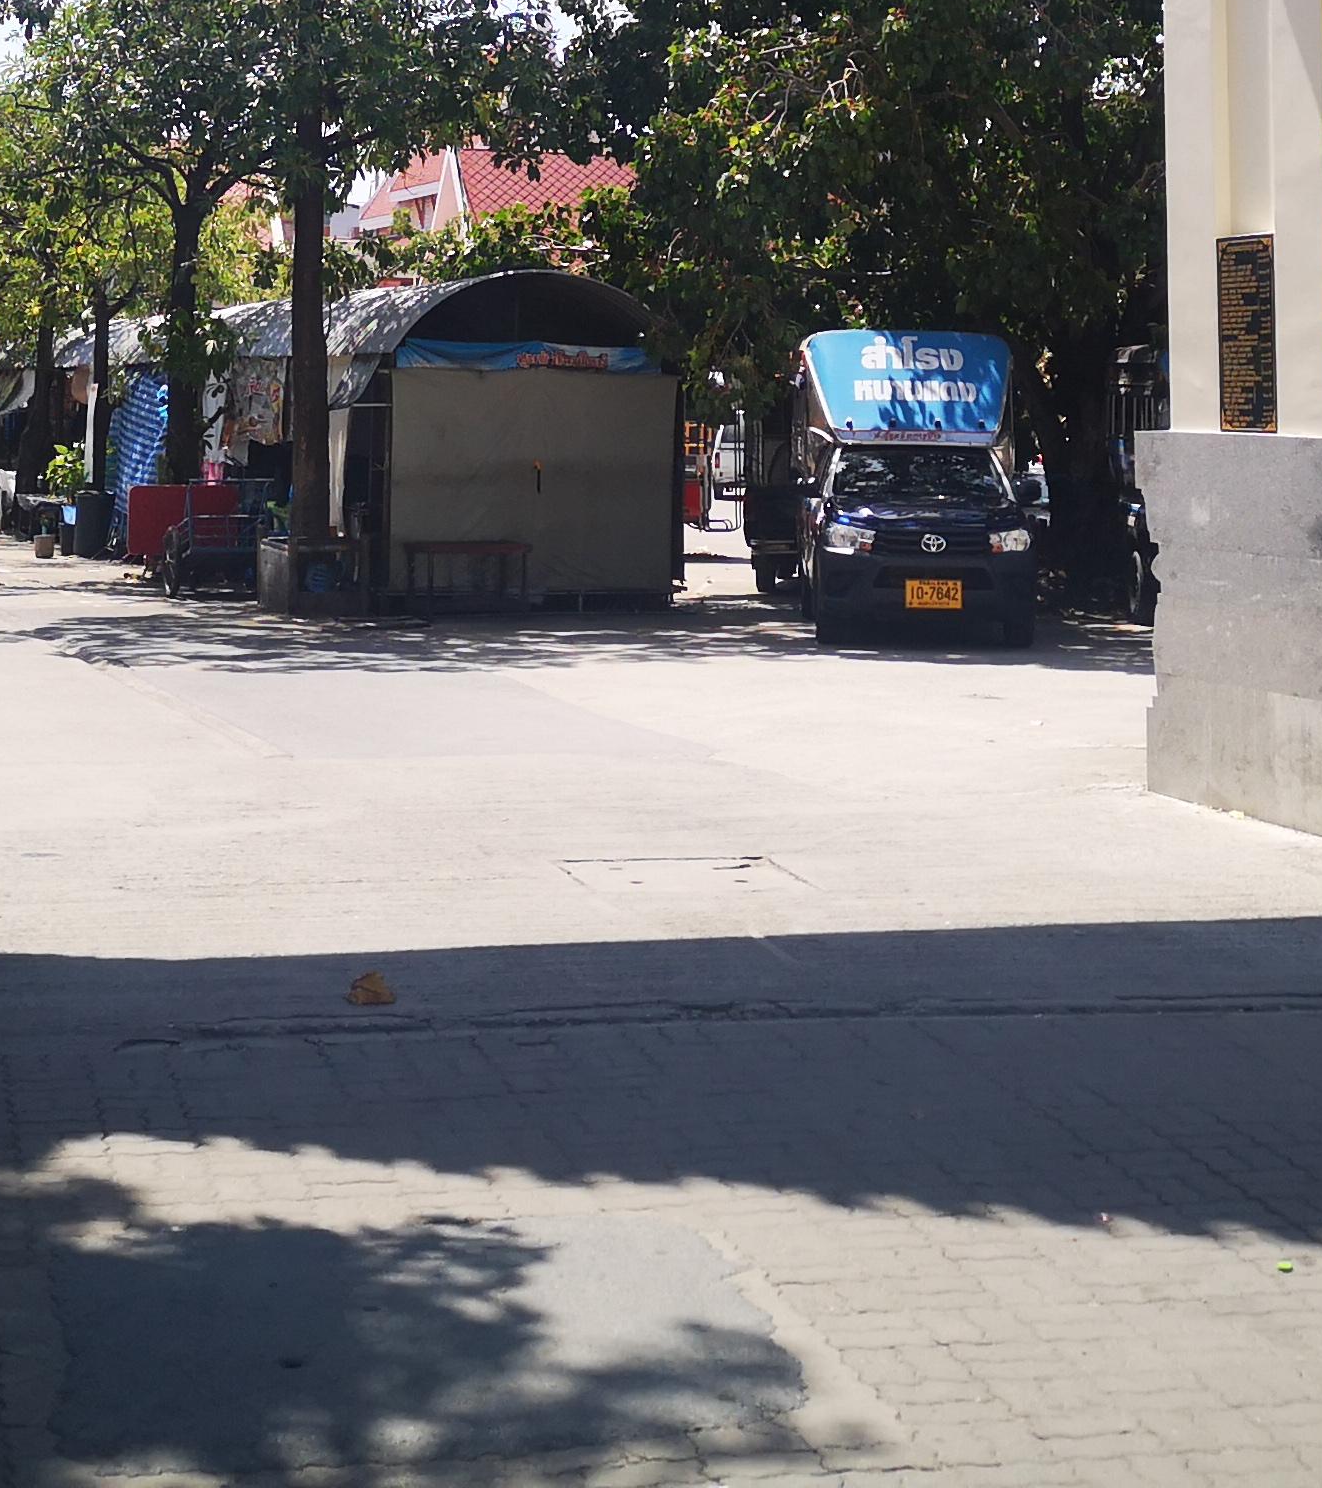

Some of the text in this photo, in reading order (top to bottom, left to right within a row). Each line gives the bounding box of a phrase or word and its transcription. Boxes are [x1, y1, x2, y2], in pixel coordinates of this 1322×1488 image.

[860, 335, 964, 372] สำโรง
[853, 379, 977, 403] หนามแดง
[910, 585, 959, 602] 10-7642
